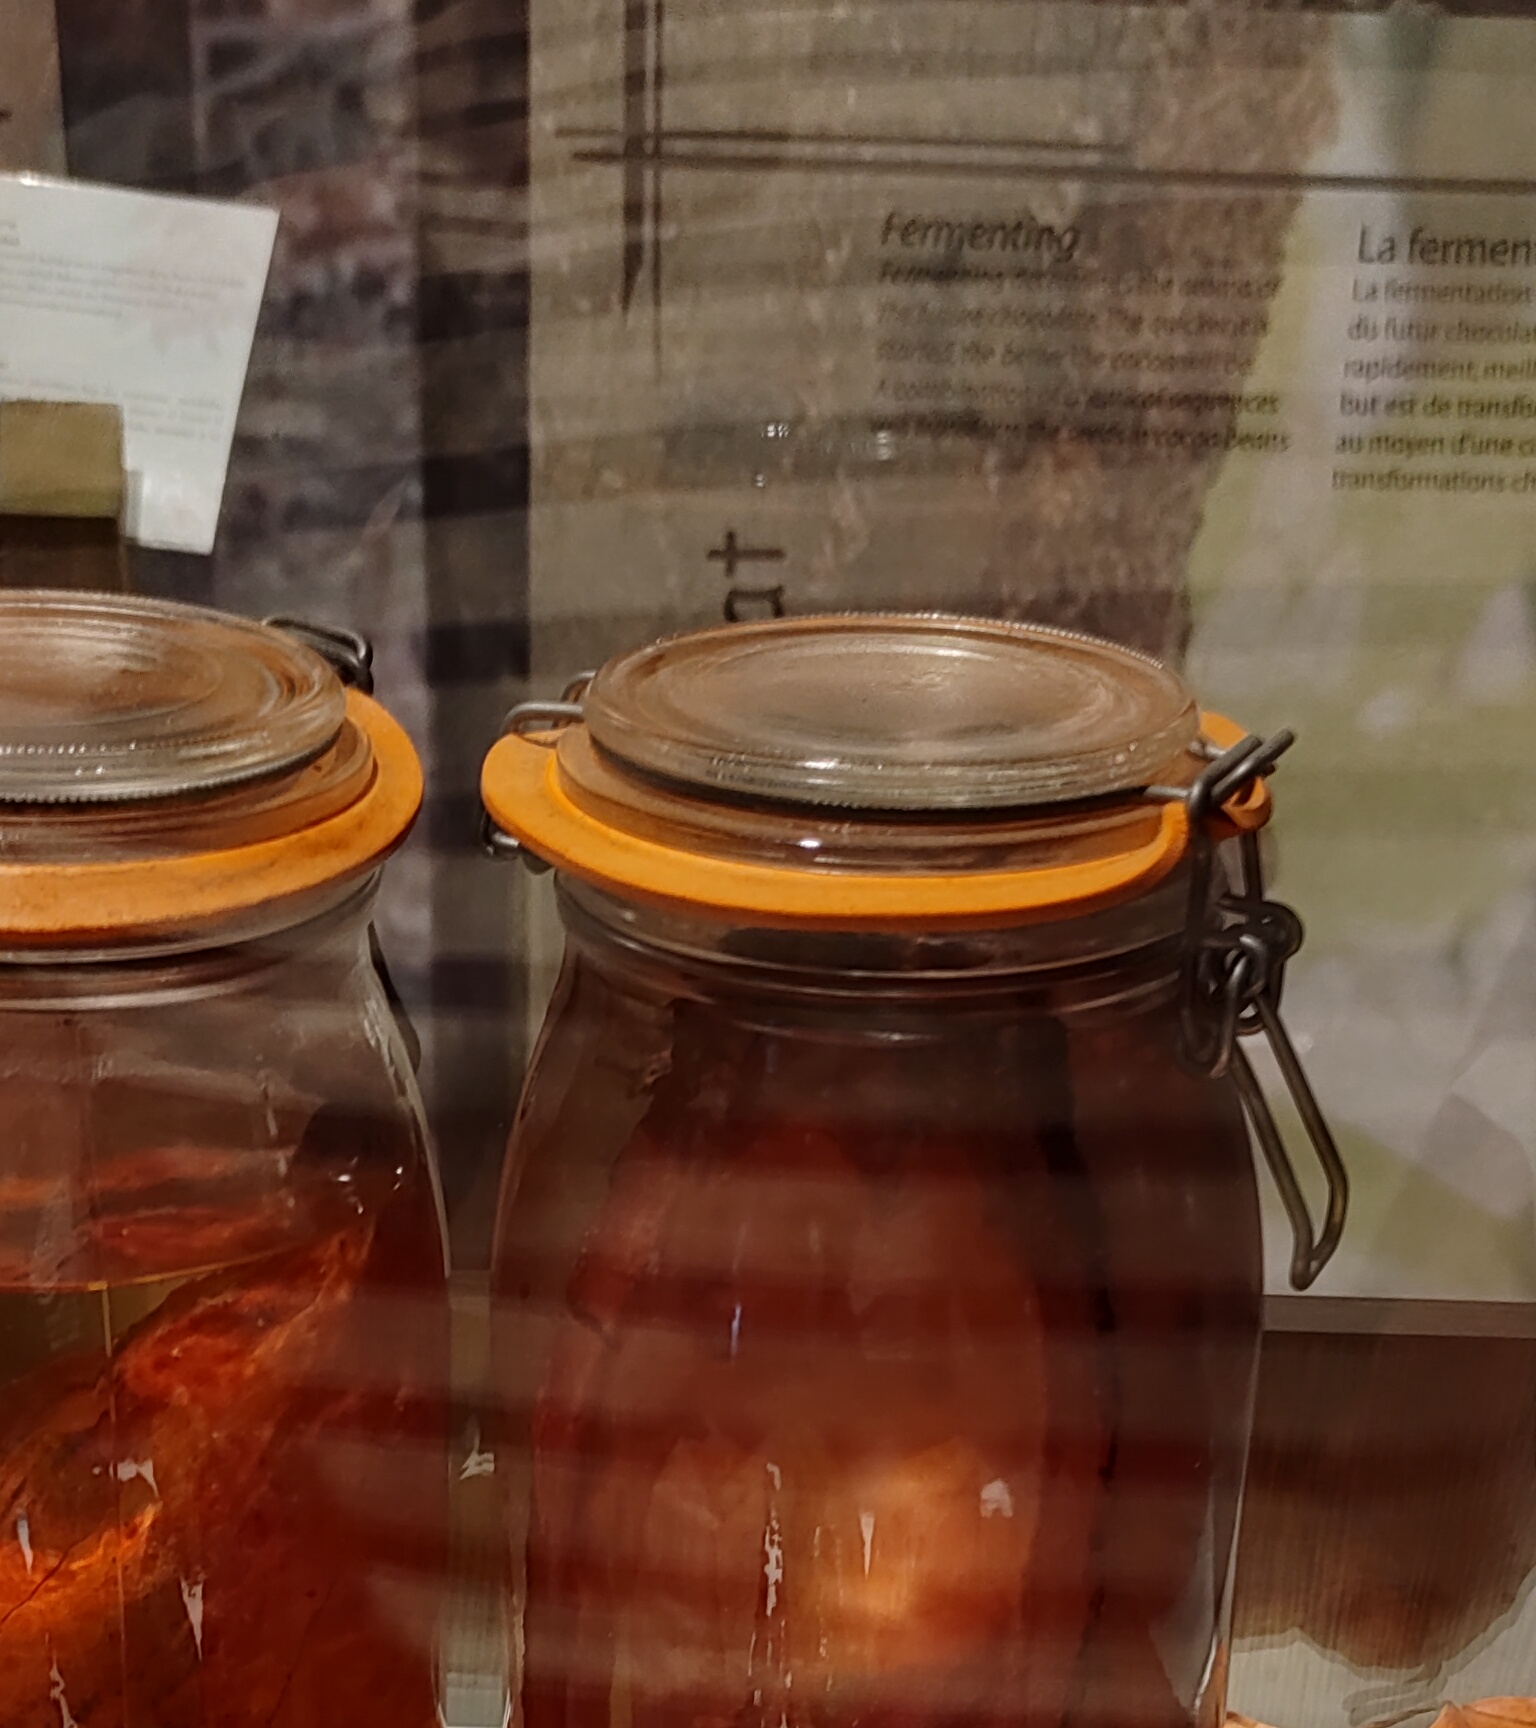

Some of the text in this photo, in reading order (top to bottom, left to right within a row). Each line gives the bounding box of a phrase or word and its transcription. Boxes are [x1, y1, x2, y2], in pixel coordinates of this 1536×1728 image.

[880, 211, 1080, 263] Fermenting
[1356, 225, 1396, 265] La
[1352, 278, 1378, 303] La
[1384, 279, 1531, 306] fermentation
[1348, 316, 1378, 342] du
[1339, 391, 1377, 418] but
[1384, 396, 1416, 418] est
[1422, 392, 1451, 418] de
[1334, 434, 1365, 456] au
[1368, 436, 1445, 461] moyen
